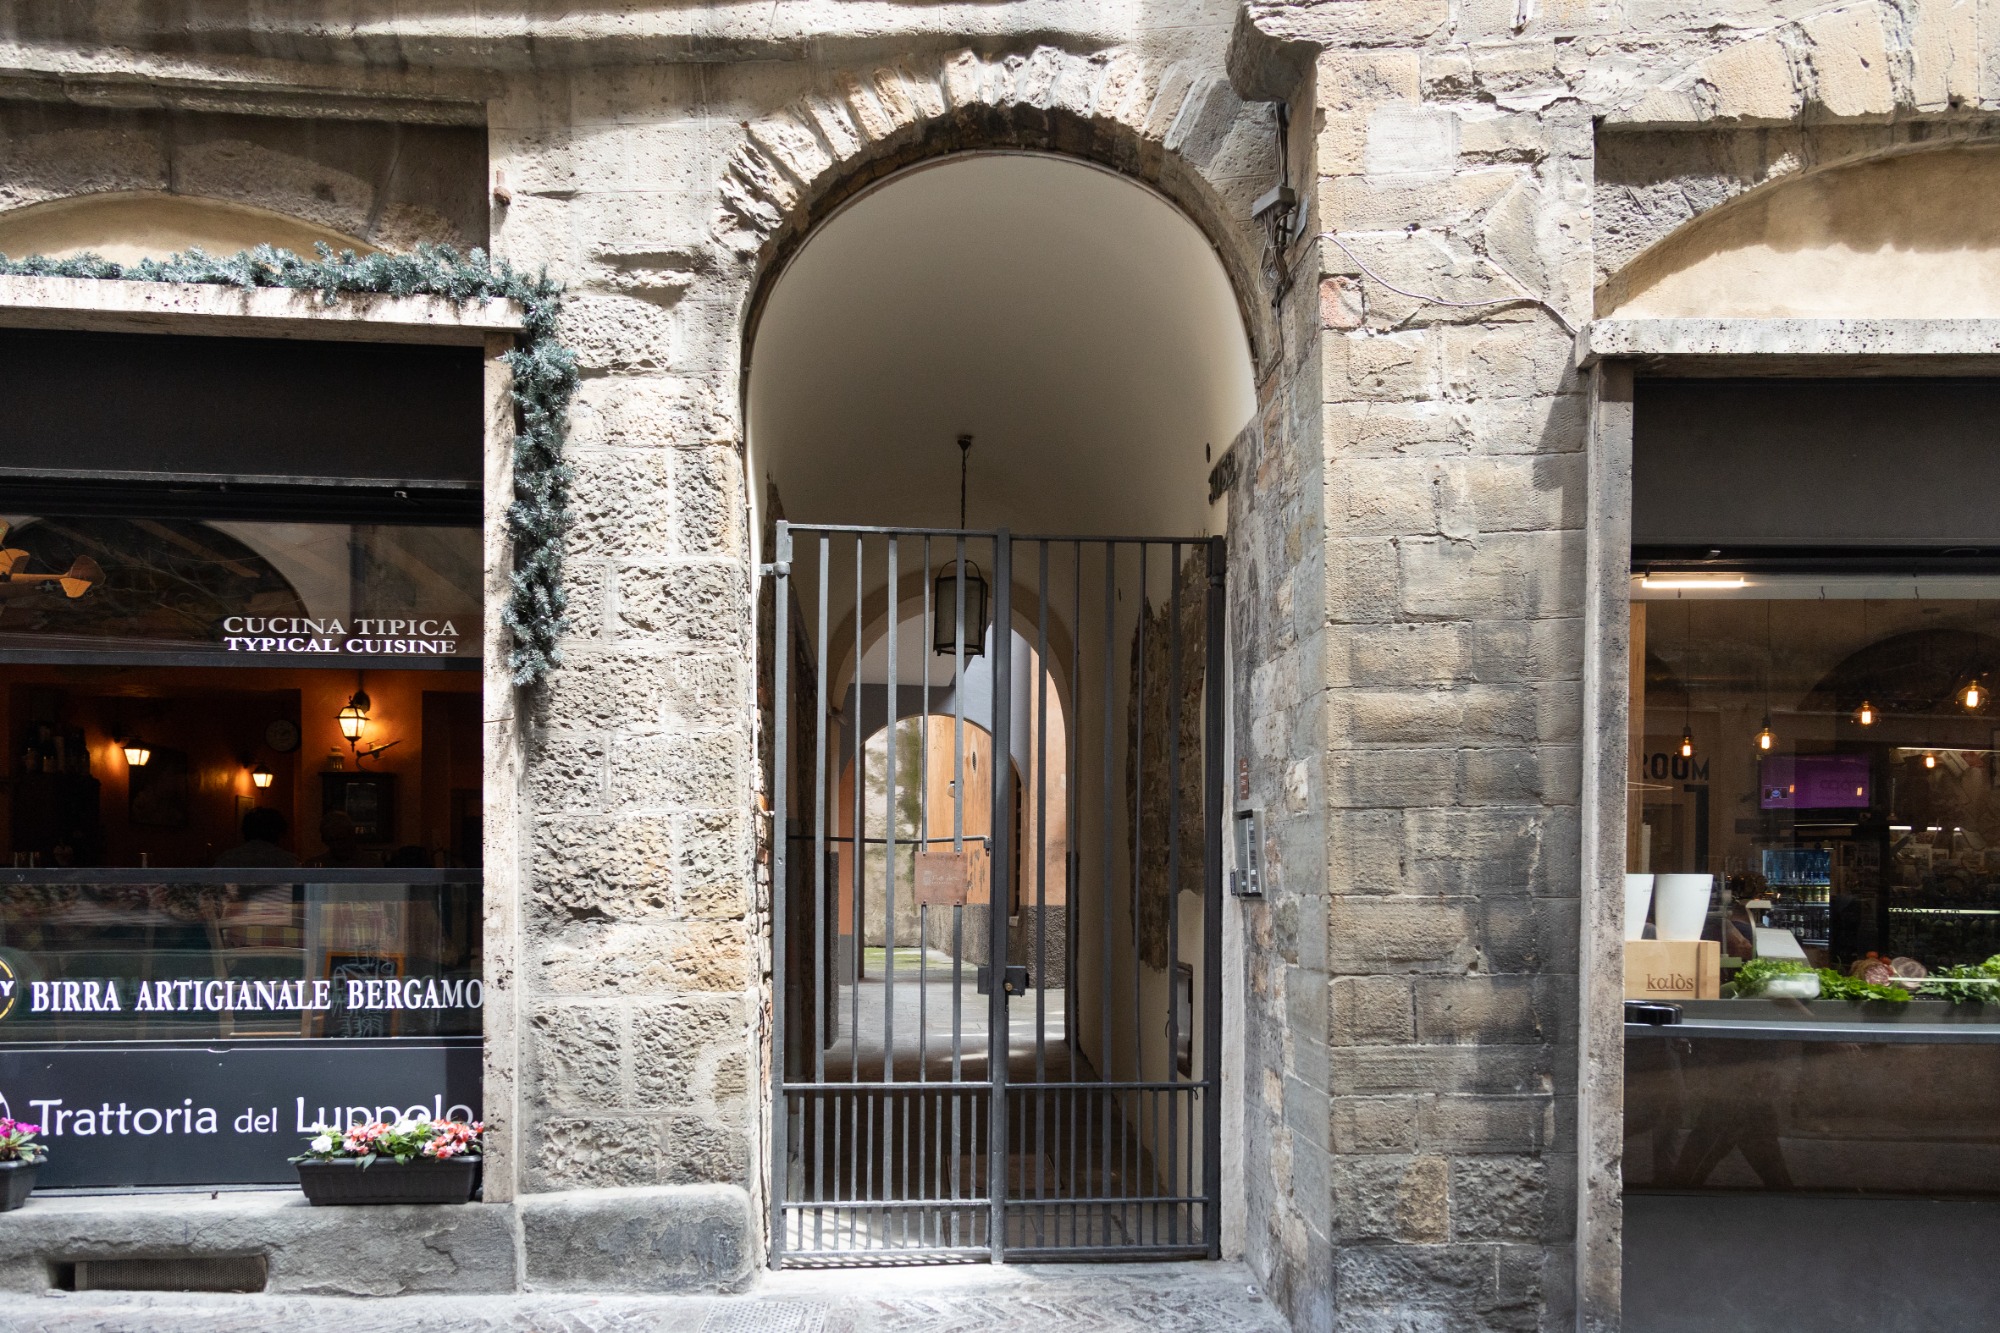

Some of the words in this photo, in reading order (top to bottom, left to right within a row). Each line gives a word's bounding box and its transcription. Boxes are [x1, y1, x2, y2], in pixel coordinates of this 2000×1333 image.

[223, 616, 347, 635] CUCINA
[353, 618, 459, 636] TIPICA
[224, 636, 339, 652] TYPICAL
[346, 639, 457, 654] CUISINE
[31, 980, 121, 1012] BIRRA
[135, 979, 331, 1011] ARTIGIANALE
[29, 1098, 218, 1136] Trattoria
[234, 1107, 278, 1133] del
